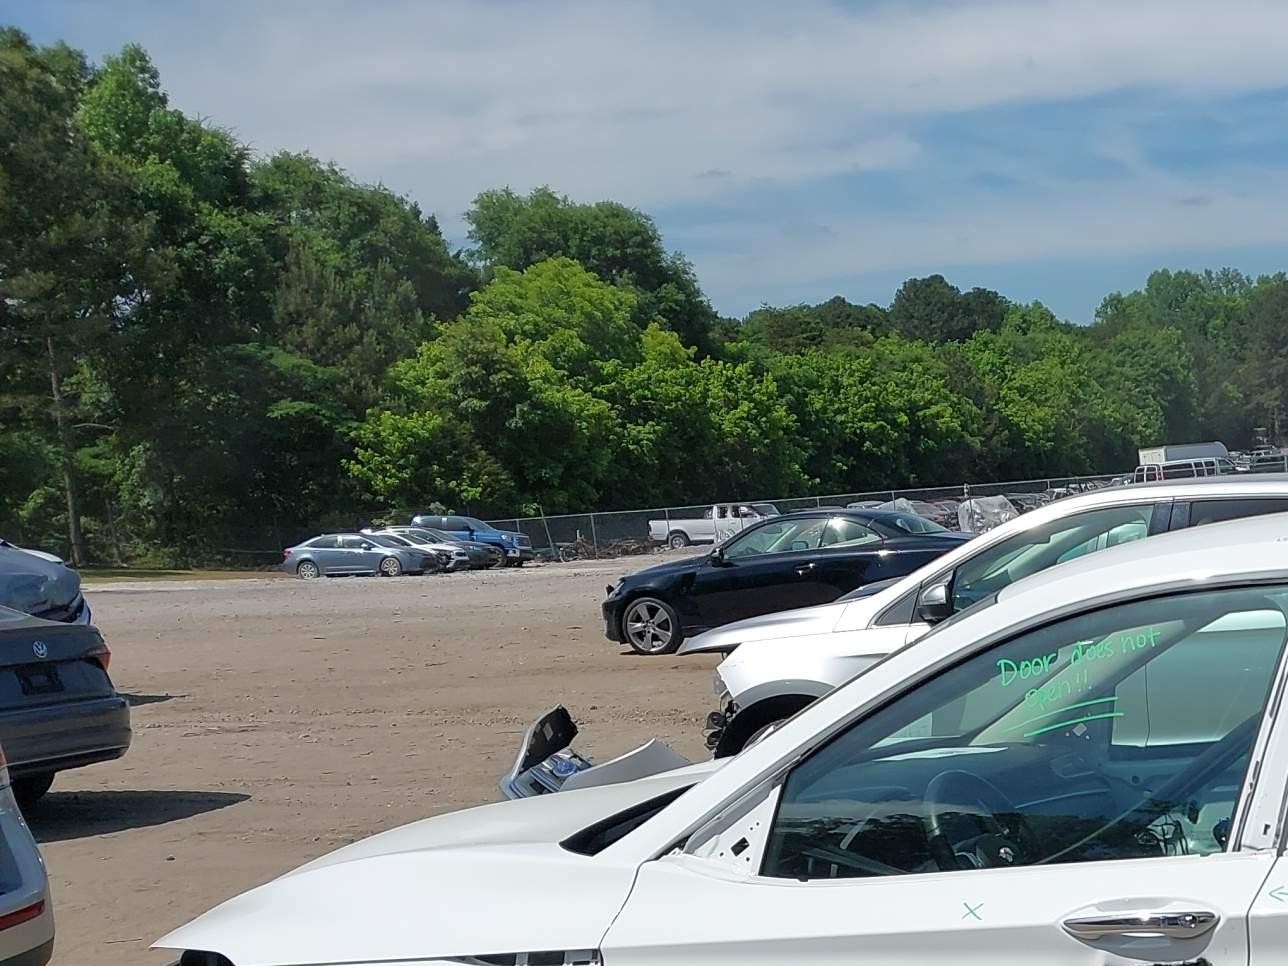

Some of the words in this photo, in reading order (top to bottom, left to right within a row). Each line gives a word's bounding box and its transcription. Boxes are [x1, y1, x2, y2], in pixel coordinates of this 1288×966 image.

[997, 652, 1056, 687] Door
[1071, 641, 1114, 665] does
[1121, 628, 1161, 653] not
